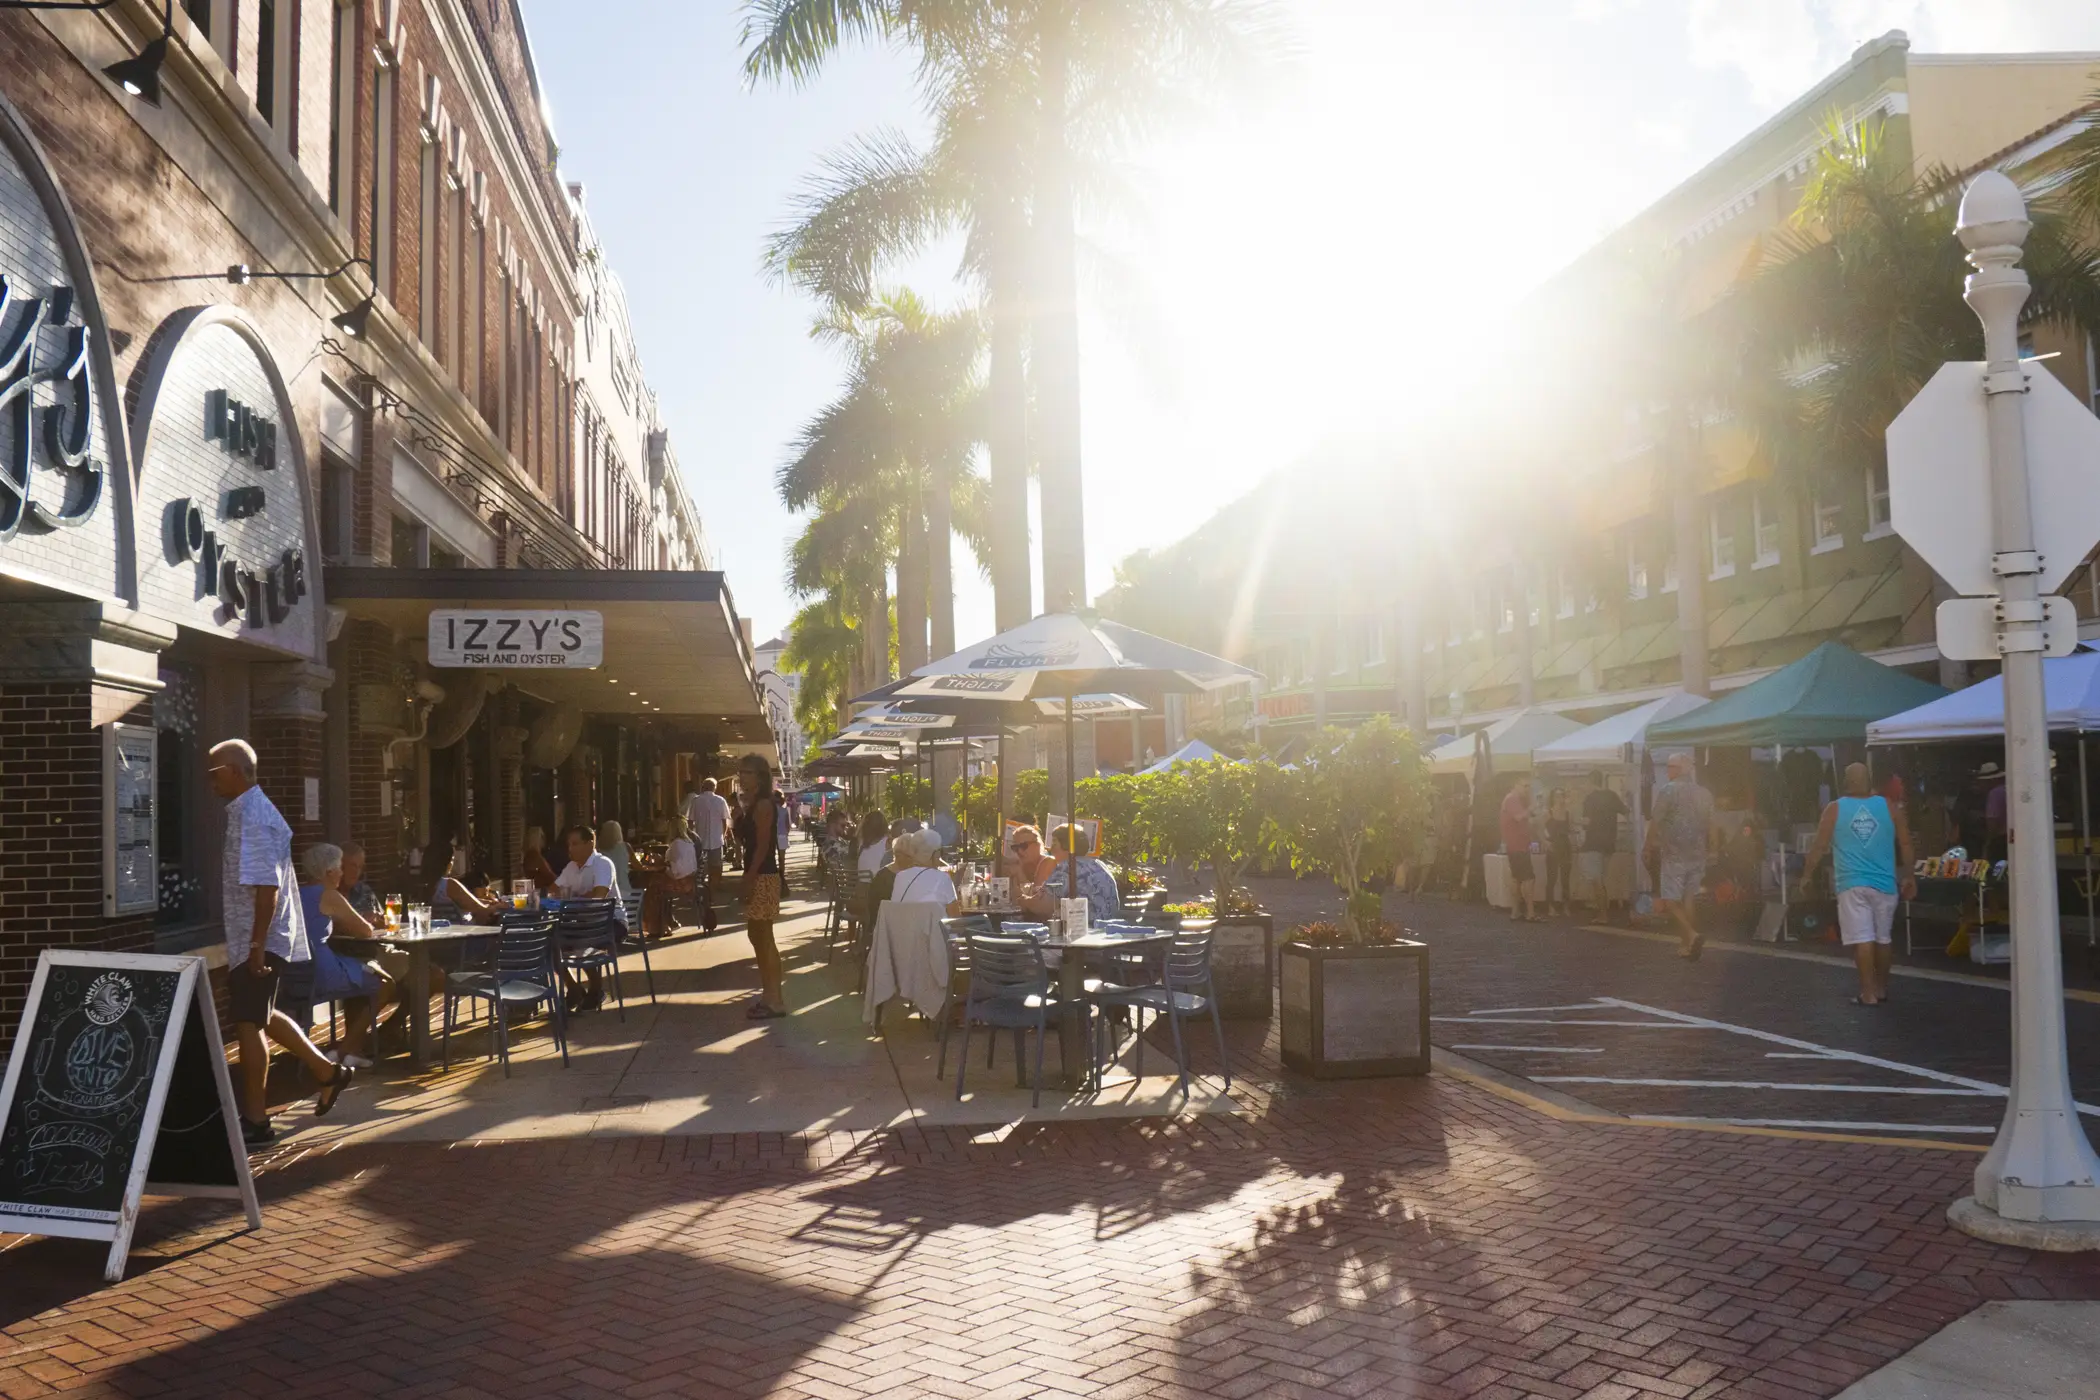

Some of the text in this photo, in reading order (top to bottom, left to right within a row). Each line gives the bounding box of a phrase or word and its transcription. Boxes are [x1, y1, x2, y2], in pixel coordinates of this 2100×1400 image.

[447, 618, 582, 651] IZZY'S
[463, 653, 566, 665] FISH AND OYSTER
[984, 656, 1061, 668] FLIGHT
[84, 971, 133, 1005] WHITE CLAW
[27, 1205, 53, 1214] CLAW
